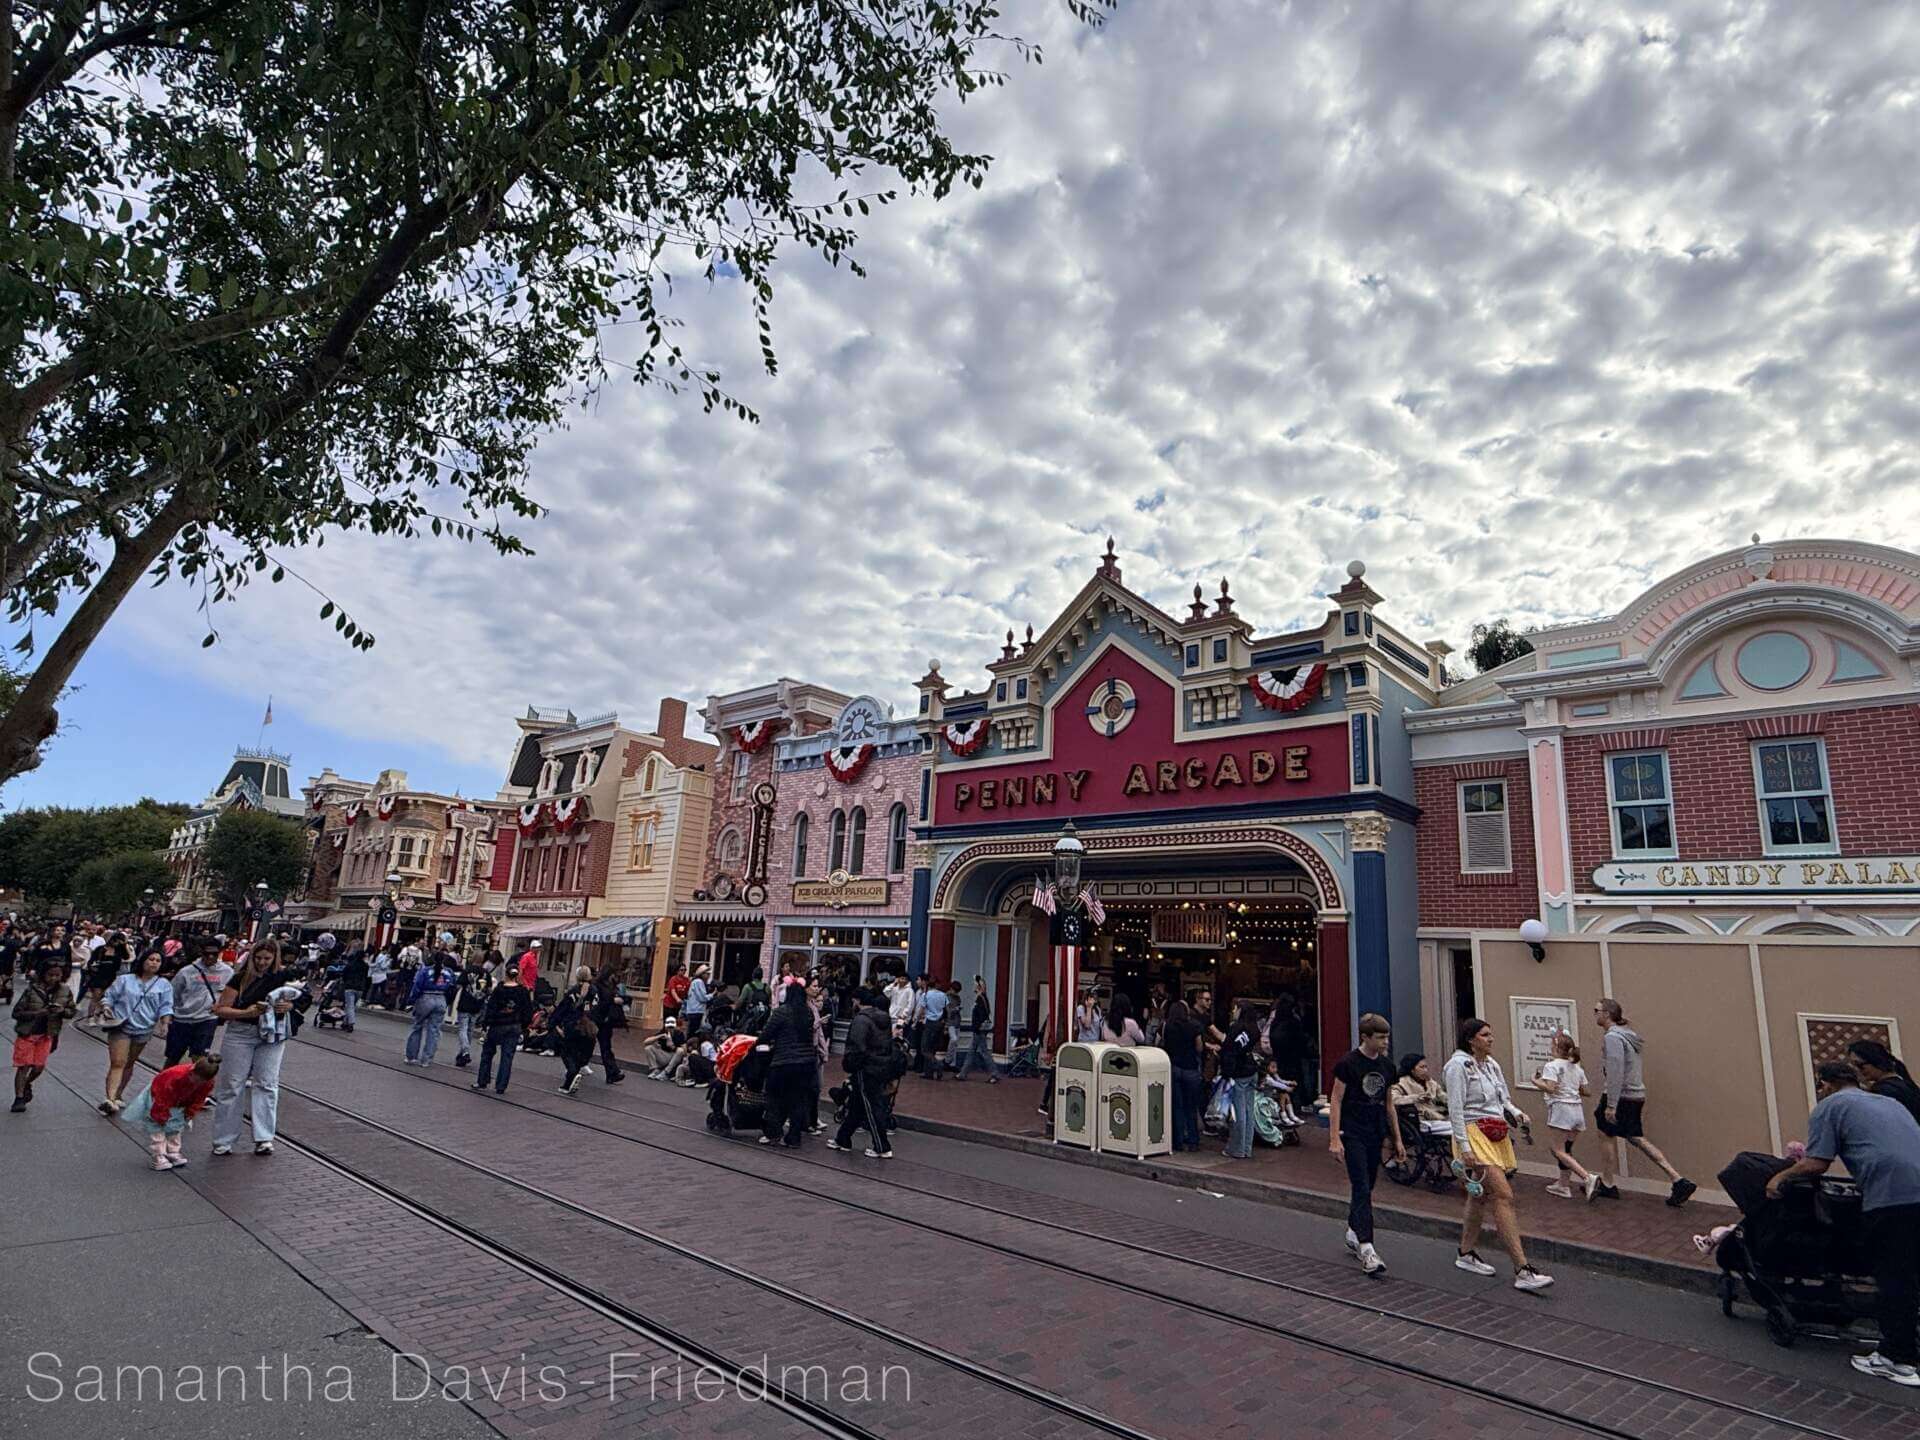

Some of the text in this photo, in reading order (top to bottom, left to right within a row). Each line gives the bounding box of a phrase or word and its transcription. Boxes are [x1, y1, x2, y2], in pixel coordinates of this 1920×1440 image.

[954, 745, 1312, 811] PENNY ARCADE
[1656, 863, 1786, 886] CANDY
[797, 886, 883, 896] ICE CREAM PARLOR
[1524, 1015, 1561, 1024] CANDY
[1524, 1022, 1556, 1031] PALA
